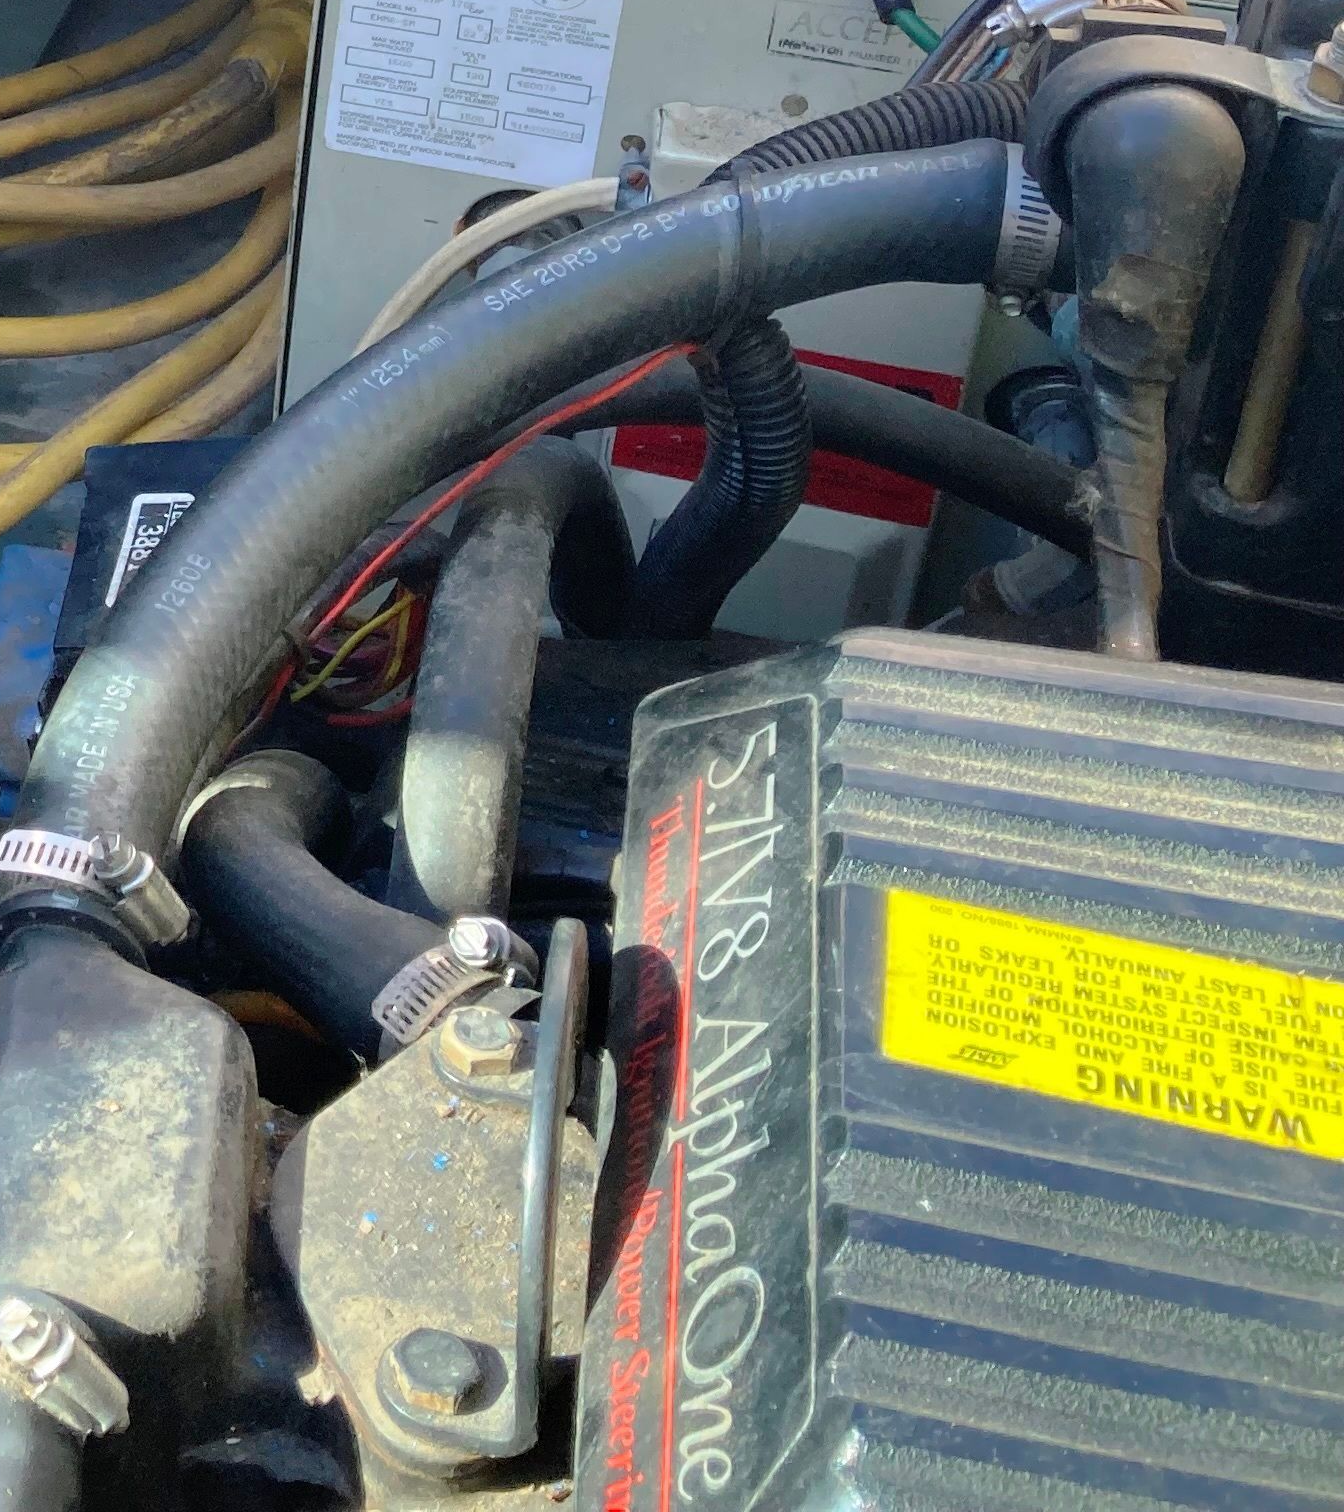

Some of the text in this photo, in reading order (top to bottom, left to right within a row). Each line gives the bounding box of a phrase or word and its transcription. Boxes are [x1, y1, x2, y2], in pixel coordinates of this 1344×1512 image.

[483, 279, 535, 313] SAE
[533, 245, 599, 287] 20R3
[71, 741, 107, 800] MADE
[928, 952, 1063, 995] REGULARLY.
[928, 970, 971, 994] THE
[928, 933, 1322, 1034] FUEL SYSTEM FOR LEAKS OR
[1060, 944, 1185, 984] ANNUALLY.
[984, 984, 1013, 1003] OF
[1074, 984, 1168, 1019] SYSTEM
[1195, 975, 1266, 1004] LEAST
[1277, 992, 1301, 1009] AT
[1028, 994, 1215, 1049] DETERIORATION
[1177, 1008, 1277, 1044] INSPECT
[926, 1007, 1343, 1116] FUEL IS A FIRE AND EXPLOSION
[928, 989, 1343, 1096] THE USE OF ALCOHOL MODIFIED
[1230, 1038, 1307, 1068] CAUSE
[1076, 1063, 1315, 1145] WARNING
